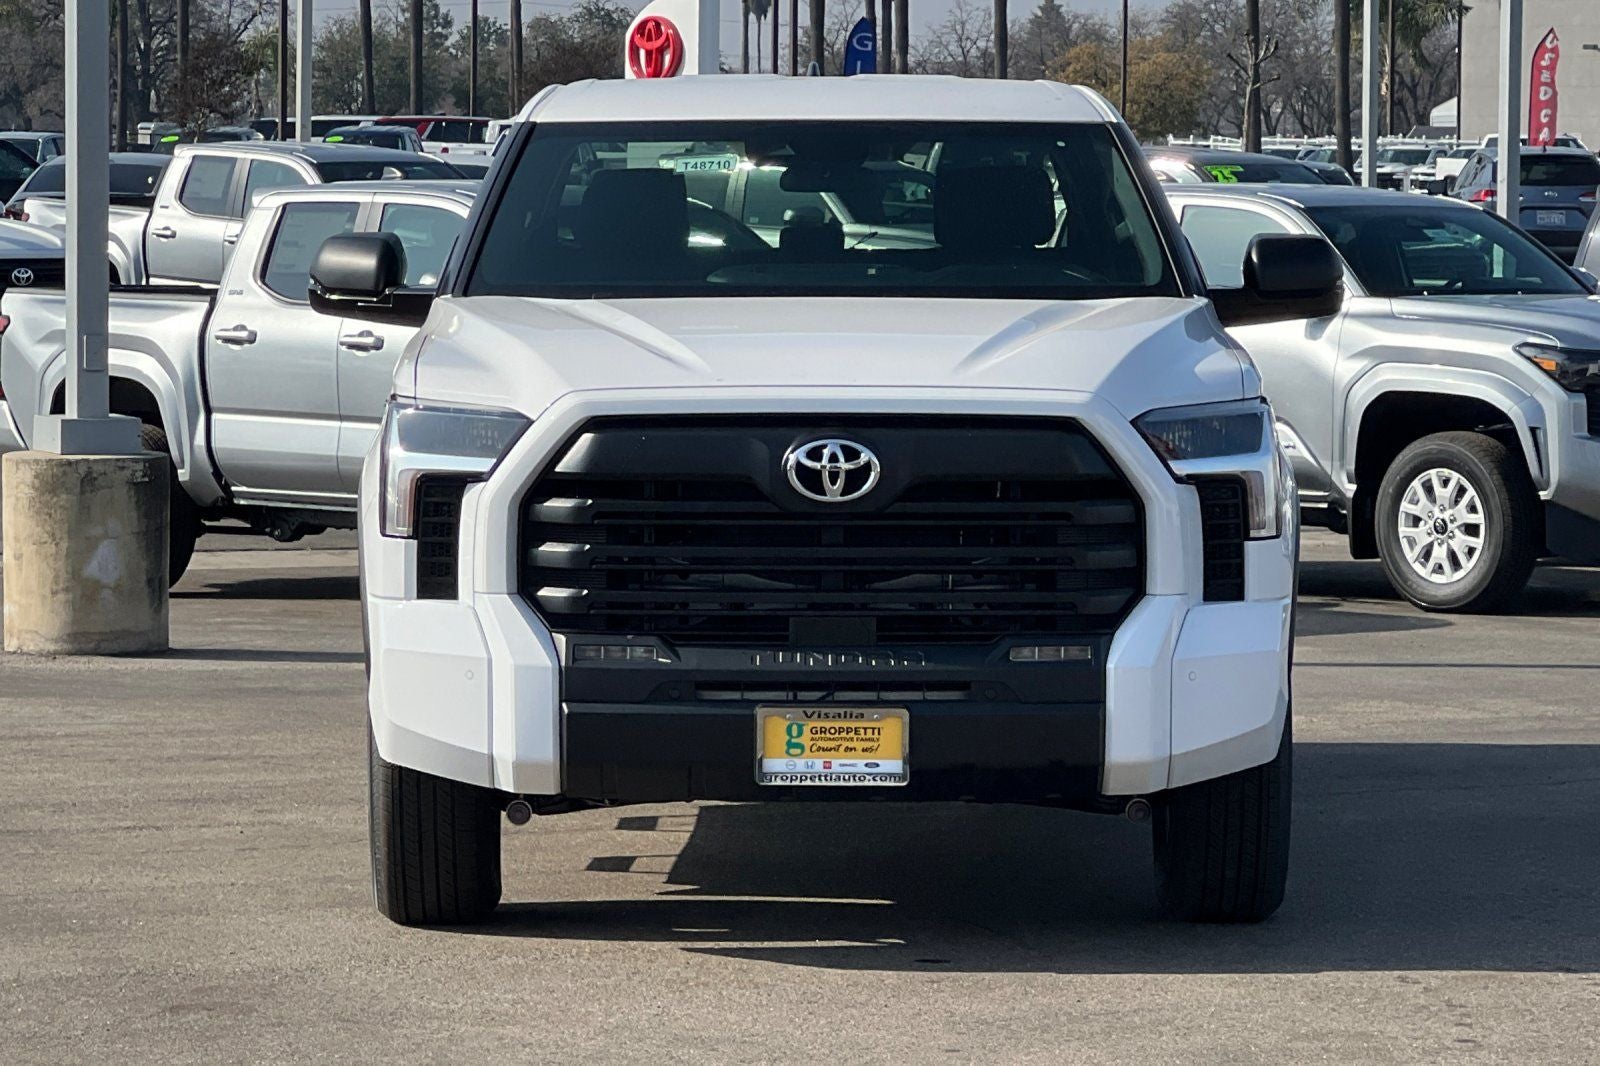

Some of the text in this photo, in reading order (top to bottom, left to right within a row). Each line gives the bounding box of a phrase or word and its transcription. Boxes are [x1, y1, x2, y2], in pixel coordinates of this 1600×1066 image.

[682, 160, 731, 170] T48710
[802, 710, 865, 720] Visalia
[809, 726, 881, 736] GROPPETTI
[809, 743, 842, 754] Count
[861, 744, 880, 754] us!
